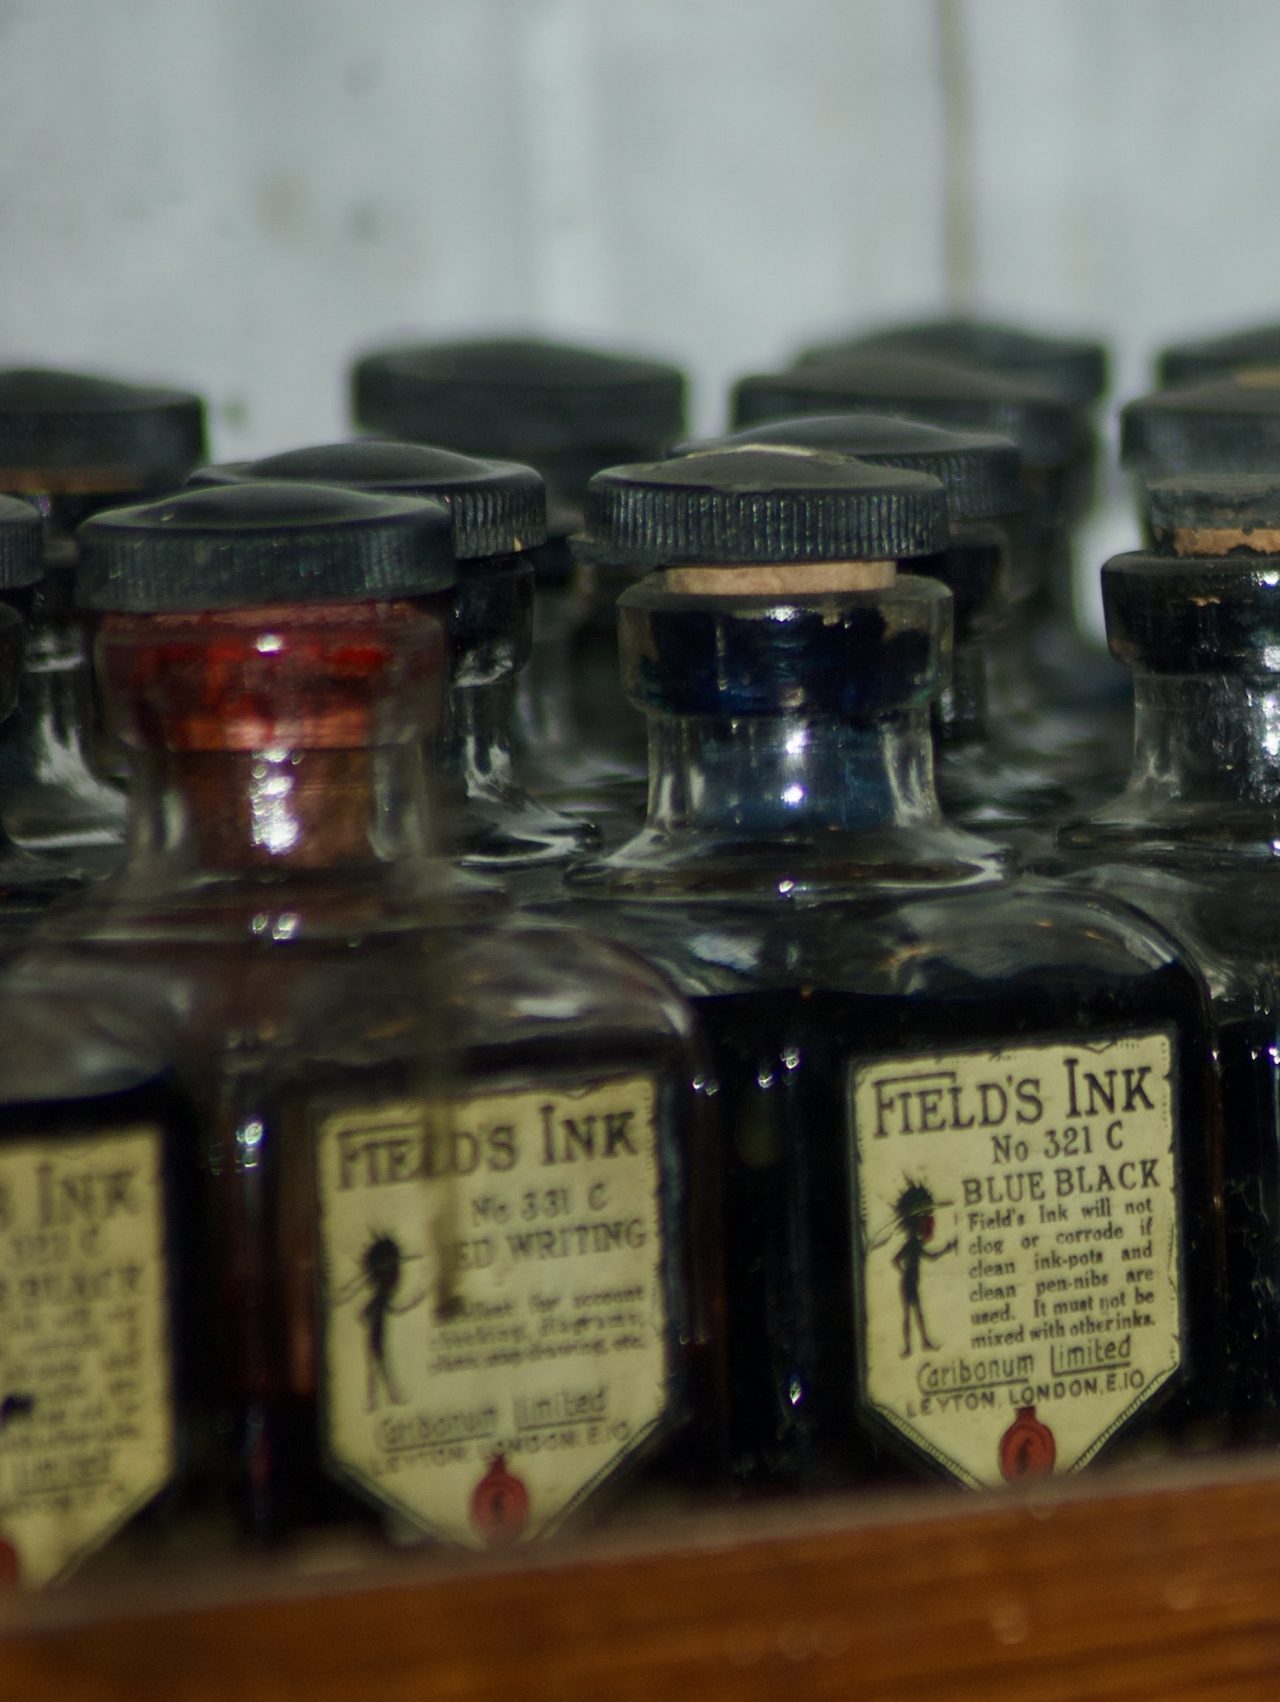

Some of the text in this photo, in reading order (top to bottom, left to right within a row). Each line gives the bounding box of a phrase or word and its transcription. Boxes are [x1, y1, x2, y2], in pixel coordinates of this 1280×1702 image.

[871, 1057, 1155, 1139] FIELD'S INK
[540, 1104, 638, 1164] INK
[991, 1120, 1123, 1163] No 321 C
[588, 1180, 610, 1210] C
[961, 1158, 1160, 1207] BLUE BLACK
[967, 1197, 1152, 1231] Field's Ink will not
[507, 1218, 646, 1258] WRITING
[969, 1217, 1152, 1255] clog or corrode if
[969, 1240, 1152, 1278] clean ink-pots and
[970, 1269, 1153, 1301] clean pen-nibs are
[1034, 1299, 1046, 1317] It
[1053, 1296, 1093, 1315] must
[1100, 1291, 1126, 1310] not
[1135, 1287, 1154, 1304] be
[971, 1324, 1024, 1348] mixed
[1030, 1320, 1065, 1340] with
[1070, 1316, 1112, 1335] other
[917, 1334, 1131, 1395] Caribonum Limited
